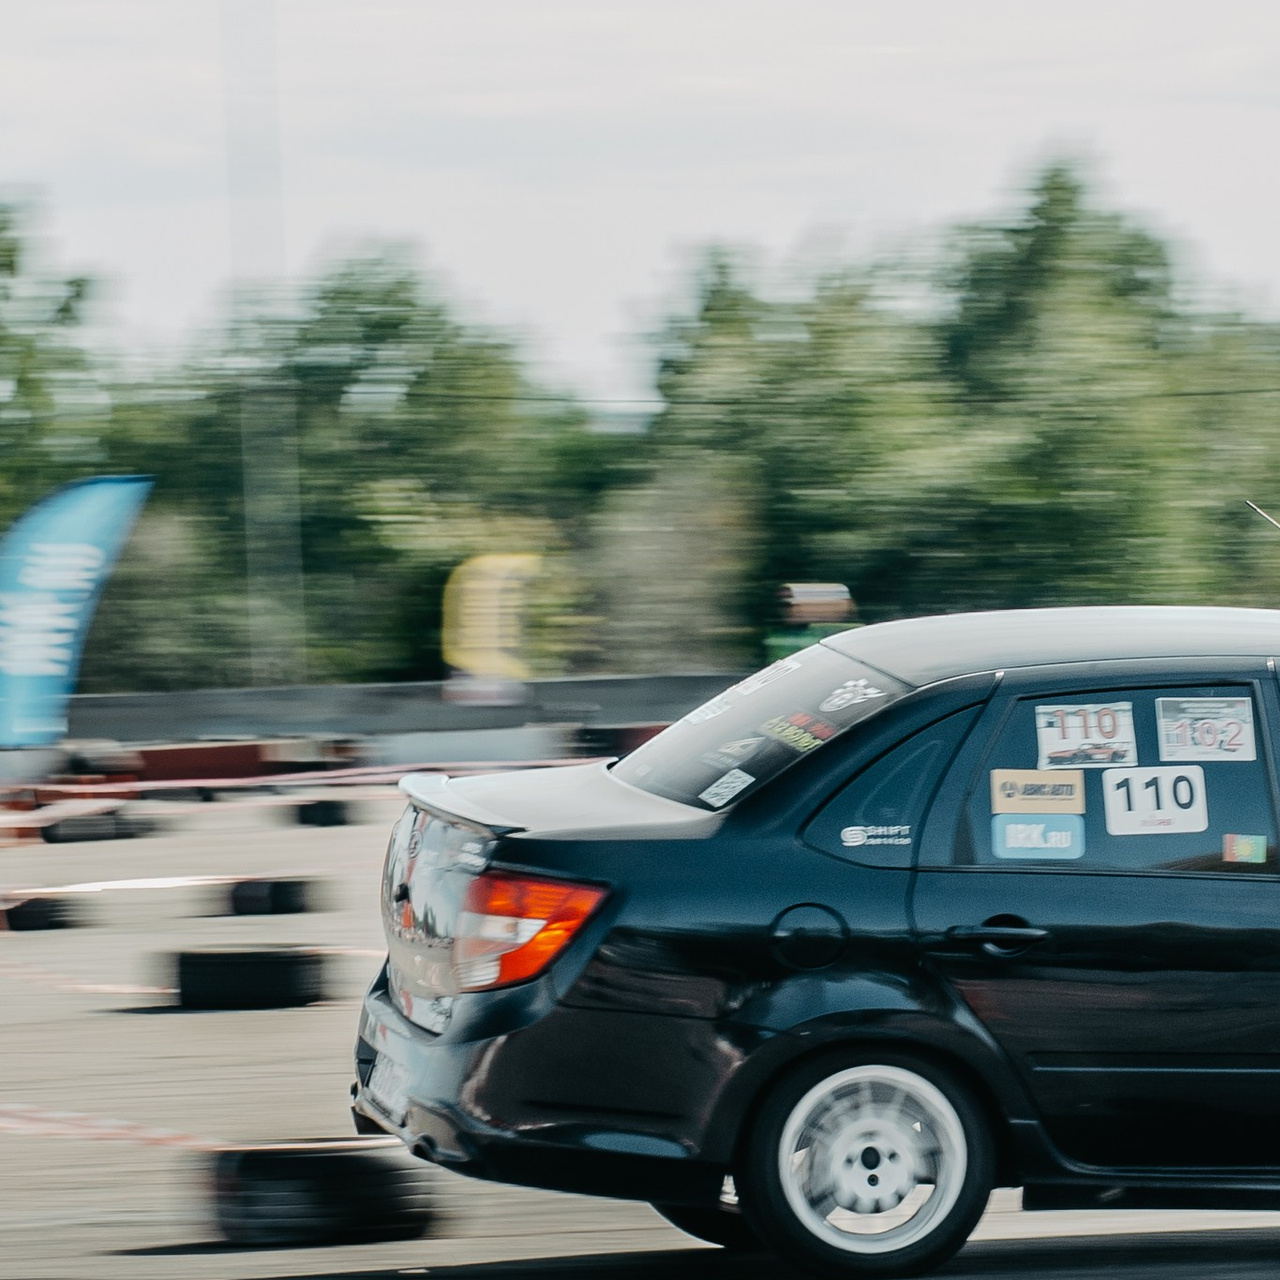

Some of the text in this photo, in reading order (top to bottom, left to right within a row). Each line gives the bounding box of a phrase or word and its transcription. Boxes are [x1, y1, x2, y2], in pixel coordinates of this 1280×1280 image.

[1053, 708, 1117, 740] 110
[1174, 721, 1245, 748] 102
[1114, 775, 1194, 812] 110
